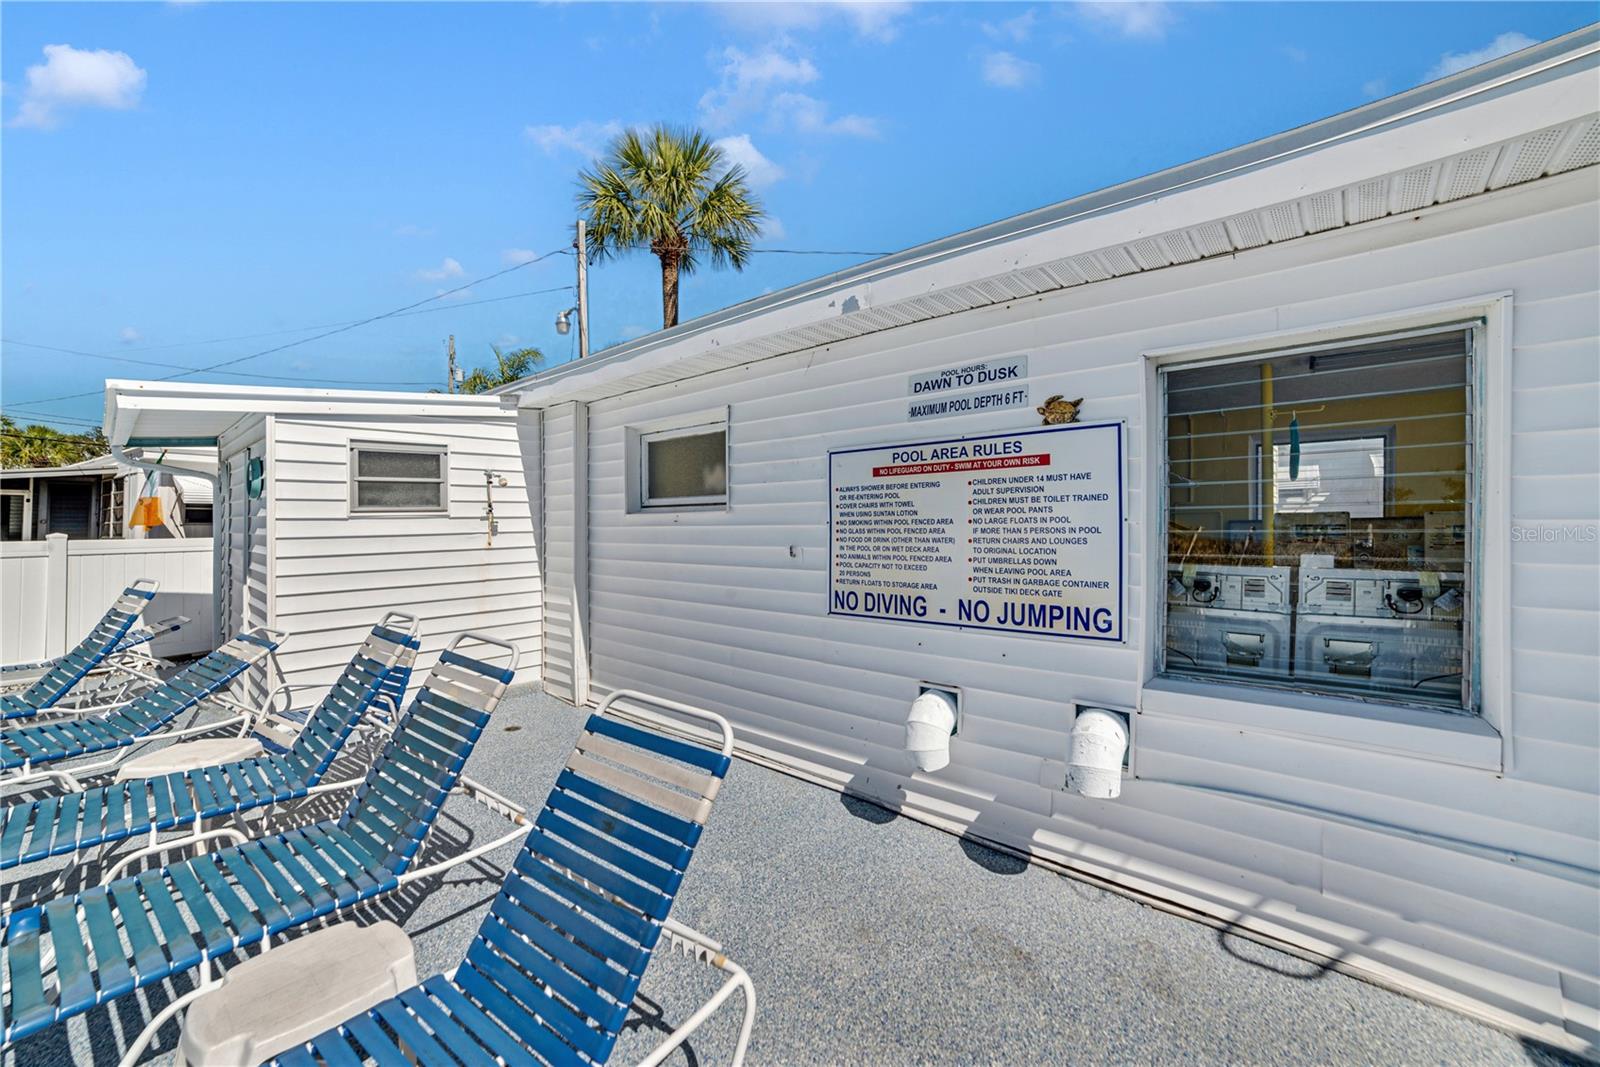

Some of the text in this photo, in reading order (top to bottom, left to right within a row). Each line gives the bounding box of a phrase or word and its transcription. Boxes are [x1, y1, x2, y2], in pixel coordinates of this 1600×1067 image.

[941, 364, 988, 377] POOL HOURS:
[914, 365, 1018, 393] DAWN TO DUSK
[949, 399, 972, 412] POOL
[974, 393, 1002, 409] DEPTH
[1005, 393, 1010, 404] 6
[892, 441, 1022, 463] POOL AREA RULES
[889, 466, 921, 474] LIFEGUARD
[955, 462, 972, 470] SWIM
[983, 460, 1002, 468] YOUR
[1022, 457, 1040, 465] RISK
[910, 481, 940, 489] ENTERING
[973, 477, 1006, 486] CHILDREN
[1009, 475, 1034, 484] UNDER
[1046, 473, 1067, 481] MUST
[1070, 472, 1091, 480] HAVE
[996, 486, 1044, 494] SUPERVISION
[988, 557, 1031, 565] UMBRELLAS
[973, 586, 1002, 594] OUTSIDE
[1022, 578, 1060, 587] GARBAGE
[1062, 580, 1109, 589] CONTAINER
[834, 590, 859, 611] NO
[864, 592, 927, 617] DIVING
[958, 599, 990, 623] NO
[997, 602, 1113, 633] JUMPING
